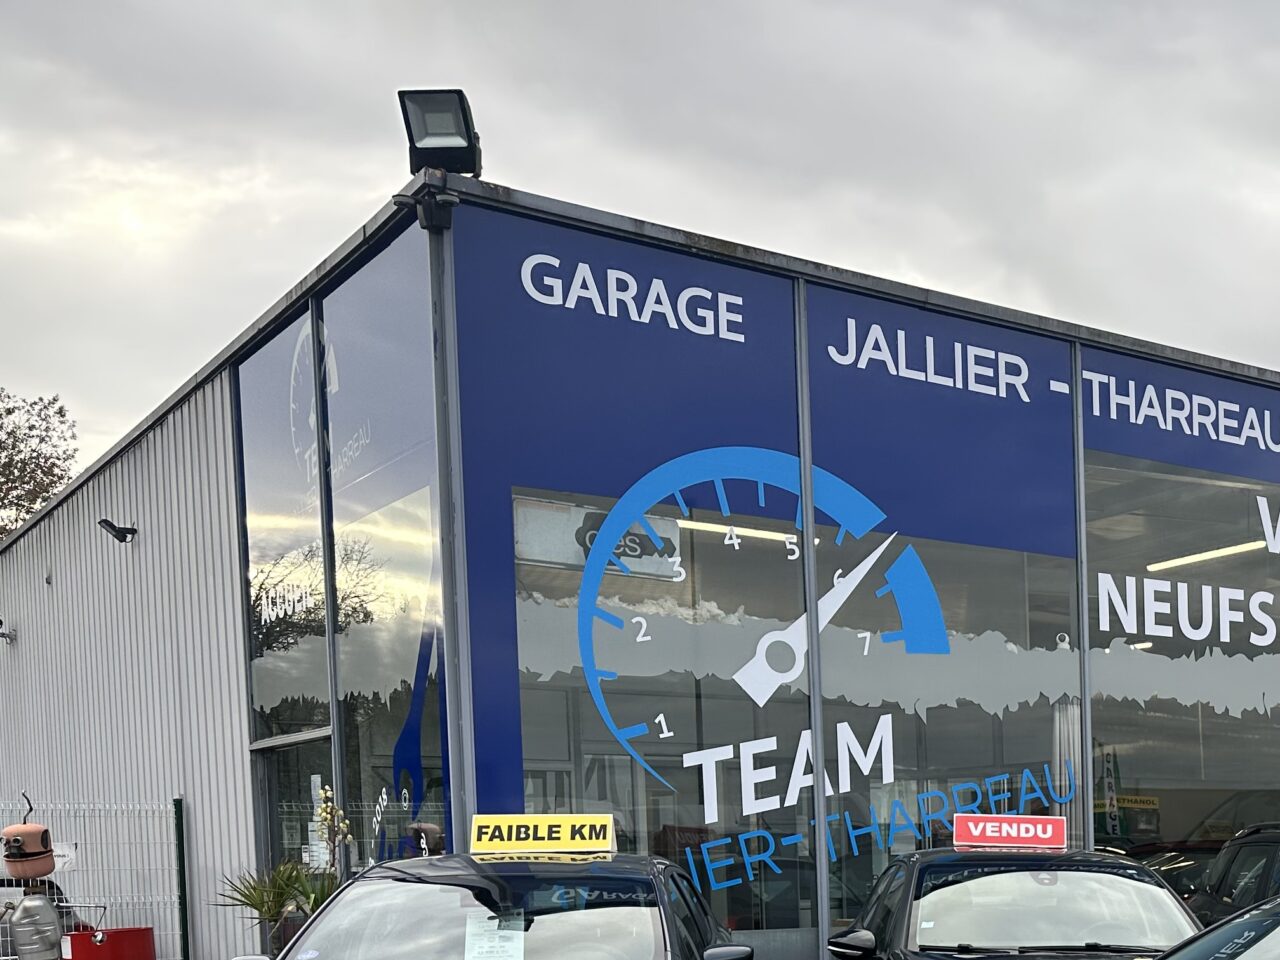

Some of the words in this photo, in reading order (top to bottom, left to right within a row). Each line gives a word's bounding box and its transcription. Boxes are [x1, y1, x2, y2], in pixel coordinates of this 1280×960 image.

[521, 254, 745, 342] GARAGE
[827, 317, 1030, 402] JALLIER
[723, 527, 741, 550] 4
[784, 535, 800, 560] 5
[667, 556, 686, 582] 3
[1097, 572, 1277, 647] NEUFS
[631, 616, 651, 643] 2
[857, 631, 871, 656] 7
[654, 713, 674, 739] 1
[682, 713, 895, 824] TEAM
[476, 824, 561, 842] FAIBLE
[570, 824, 608, 841] KM
[967, 820, 1053, 839] VENDU
